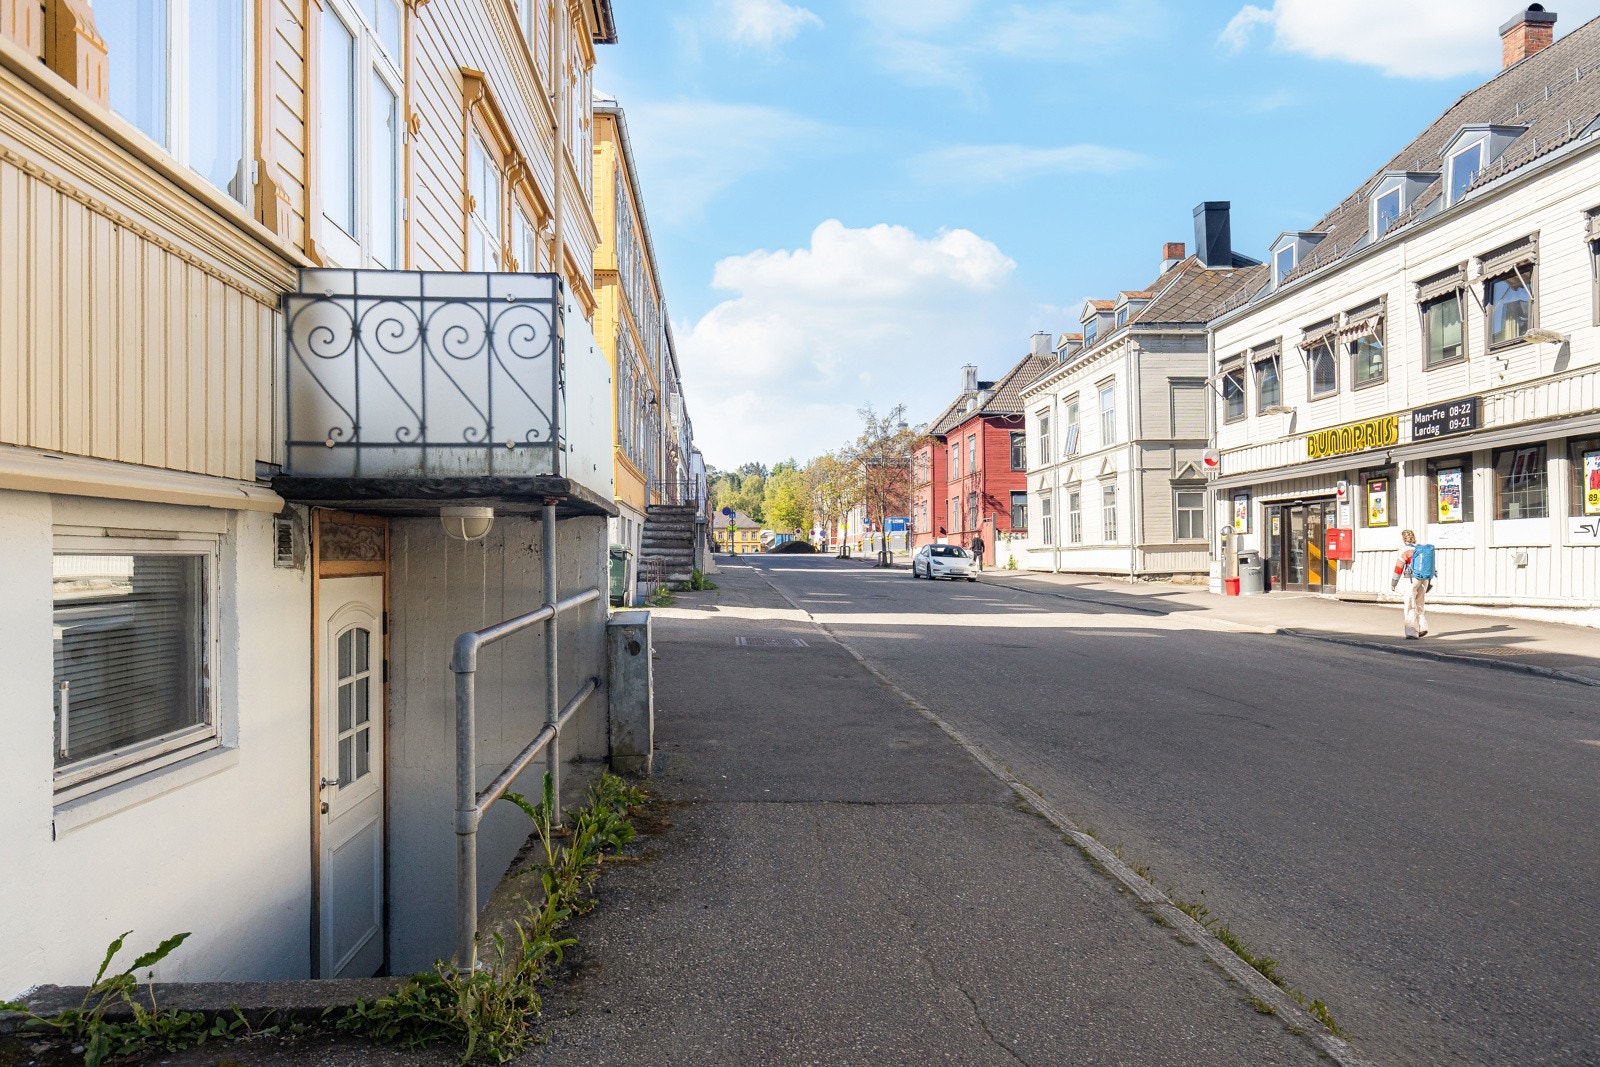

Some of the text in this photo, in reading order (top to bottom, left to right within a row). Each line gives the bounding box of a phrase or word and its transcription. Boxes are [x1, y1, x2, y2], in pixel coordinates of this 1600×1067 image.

[1414, 403, 1471, 424] Man-Fre 08-22
[1414, 416, 1471, 437] Lørdag 09-21
[1306, 416, 1398, 459] BUNNPRIS
